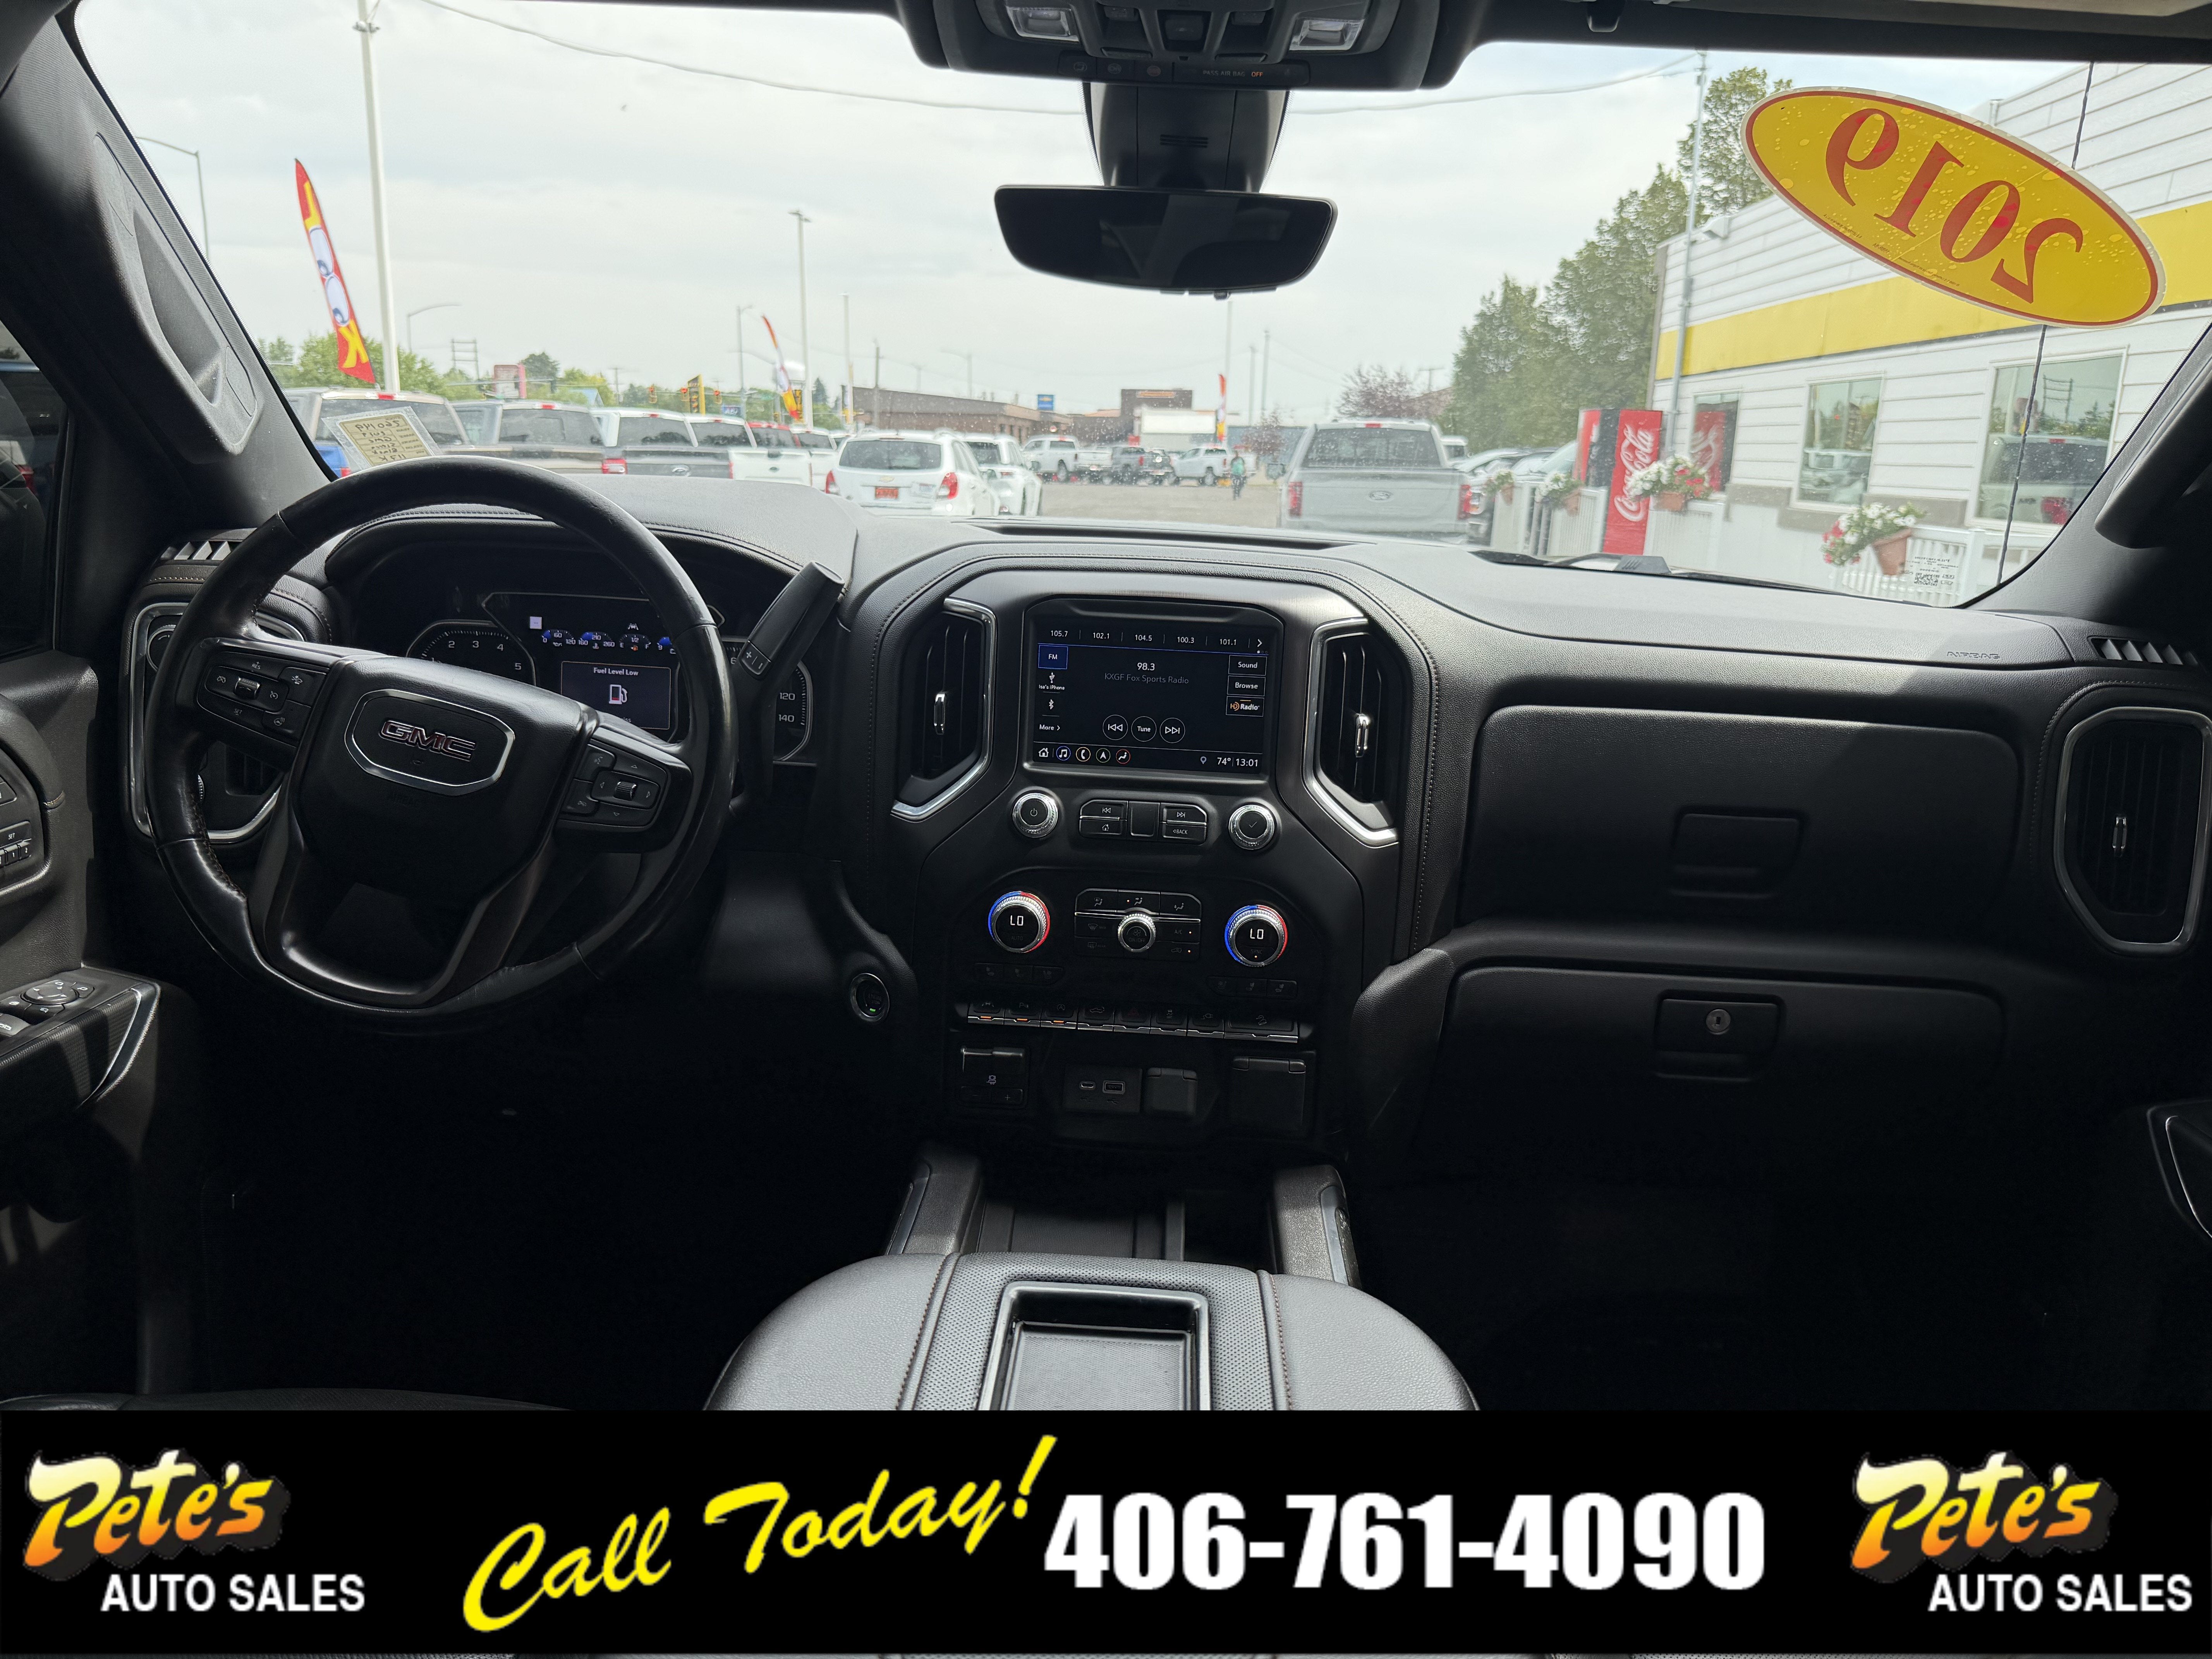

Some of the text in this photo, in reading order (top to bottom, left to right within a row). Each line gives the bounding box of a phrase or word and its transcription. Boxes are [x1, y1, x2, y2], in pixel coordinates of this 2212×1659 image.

[1137, 663, 1155, 671] 98.3
[1142, 675, 1166, 684] Sports
[780, 692, 795, 701] 120
[378, 720, 477, 762] GMC
[1236, 758, 1258, 767] 13:01
[1010, 915, 1024, 926] LO
[1250, 928, 1264, 939] LO
